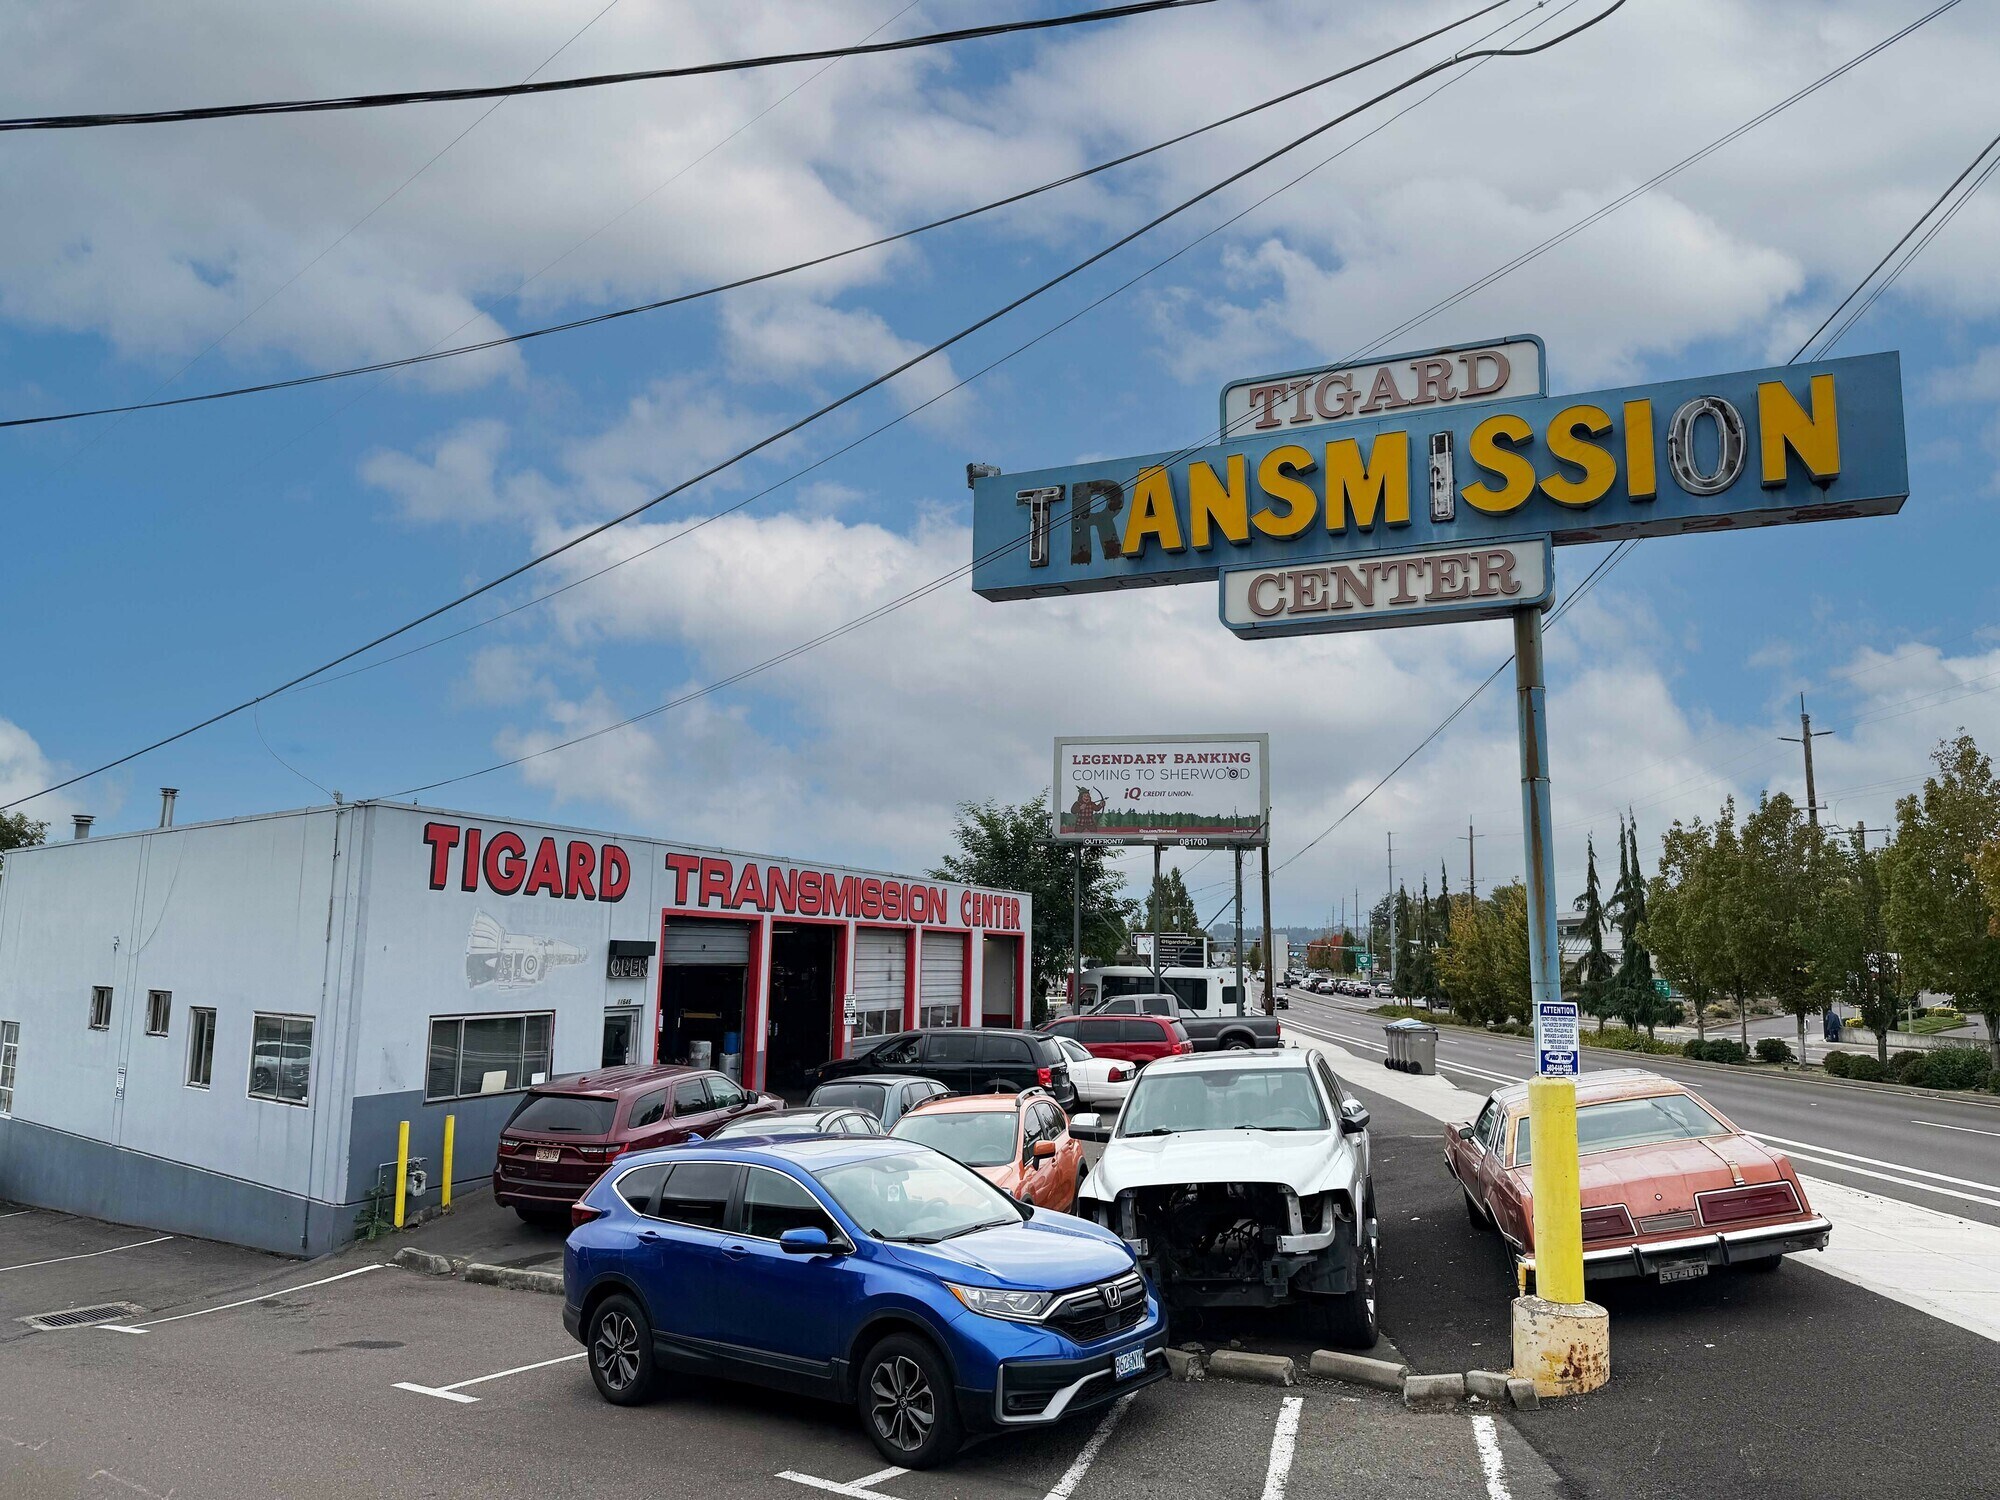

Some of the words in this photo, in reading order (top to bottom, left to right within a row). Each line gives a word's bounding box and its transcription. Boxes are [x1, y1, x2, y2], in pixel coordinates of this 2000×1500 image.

[1248, 349, 1511, 430] TIGARD
[1014, 373, 1843, 569] TRANSMISSION
[1247, 547, 1522, 617] CENTER
[1072, 753, 1168, 765] LEGENDARY
[1174, 752, 1251, 764] BANKING
[1072, 769, 1131, 781] COMING
[1136, 769, 1155, 781] TO
[1160, 767, 1251, 781] SHERWOOD
[423, 821, 631, 903] TIGARD
[1179, 838, 1208, 846] 081700
[665, 852, 948, 925] TRANSMISSION
[960, 889, 1021, 931] CENTER
[610, 957, 648, 977] OPEN
[1542, 1005, 1575, 1014] ATTENTION
